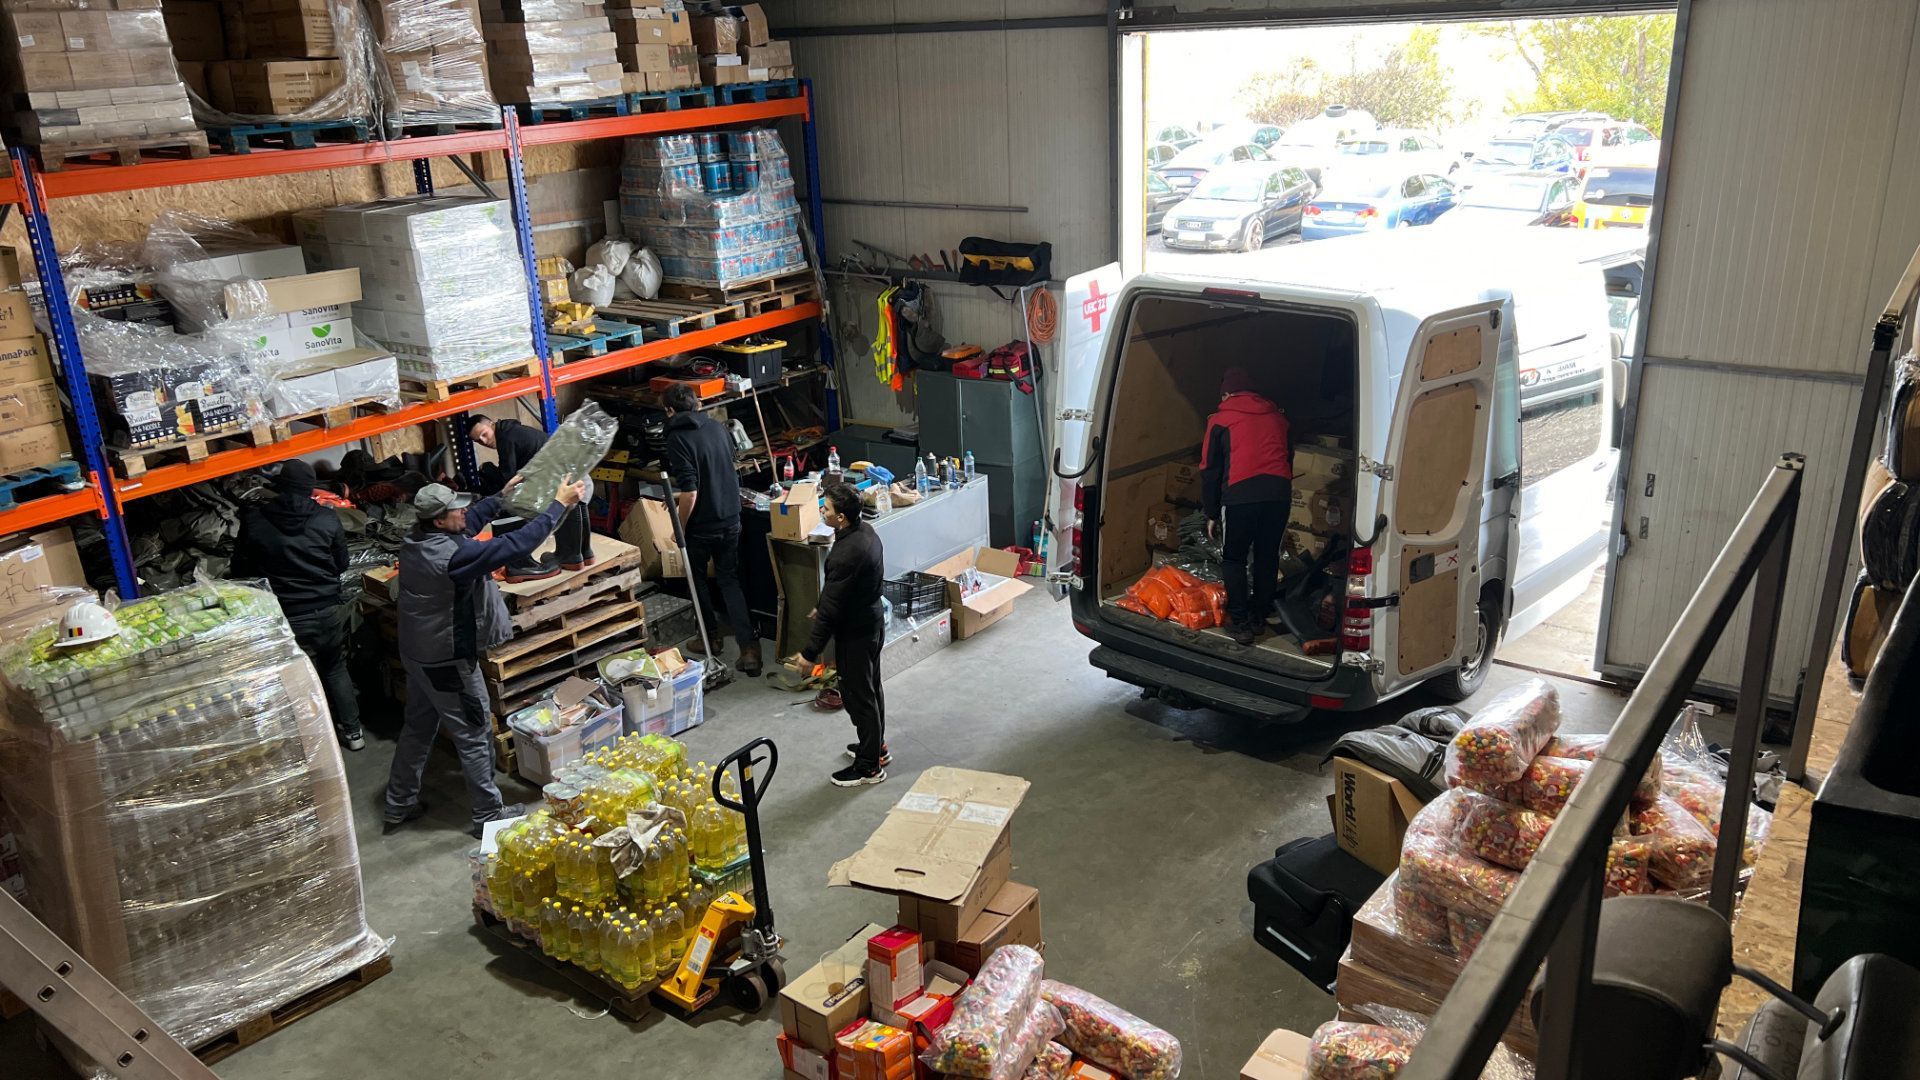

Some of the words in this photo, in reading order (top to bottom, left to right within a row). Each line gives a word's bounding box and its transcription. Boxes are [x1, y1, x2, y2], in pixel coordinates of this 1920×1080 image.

[305, 337, 342, 350] SanoVita
[142, 421, 162, 432] NOODLE
[1344, 772, 1356, 822] World
